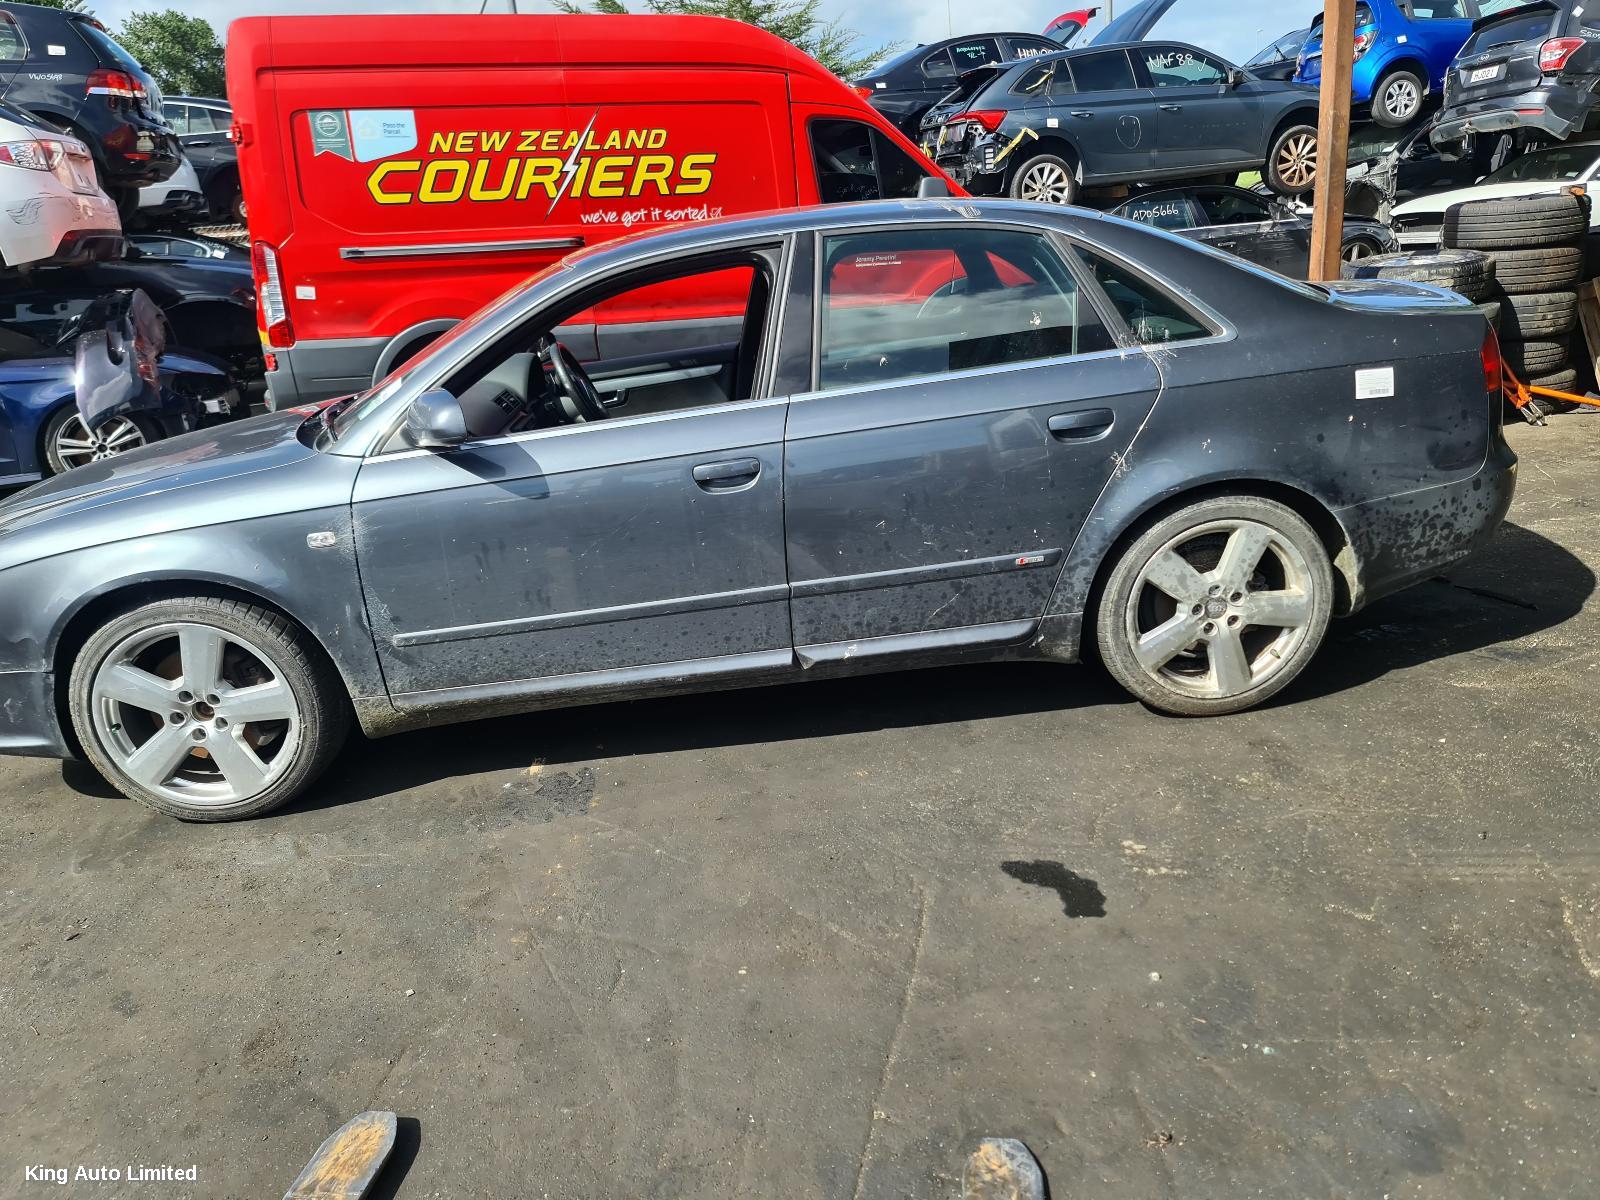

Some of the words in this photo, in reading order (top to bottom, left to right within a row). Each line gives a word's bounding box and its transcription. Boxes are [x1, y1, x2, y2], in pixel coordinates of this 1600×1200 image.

[428, 131, 513, 154] NEW
[515, 129, 668, 152] ZEALAND
[366, 153, 718, 205] COURIERS
[580, 209, 619, 224] we've
[621, 207, 648, 228] got
[650, 207, 662, 221] it
[663, 203, 709, 221] sorted
